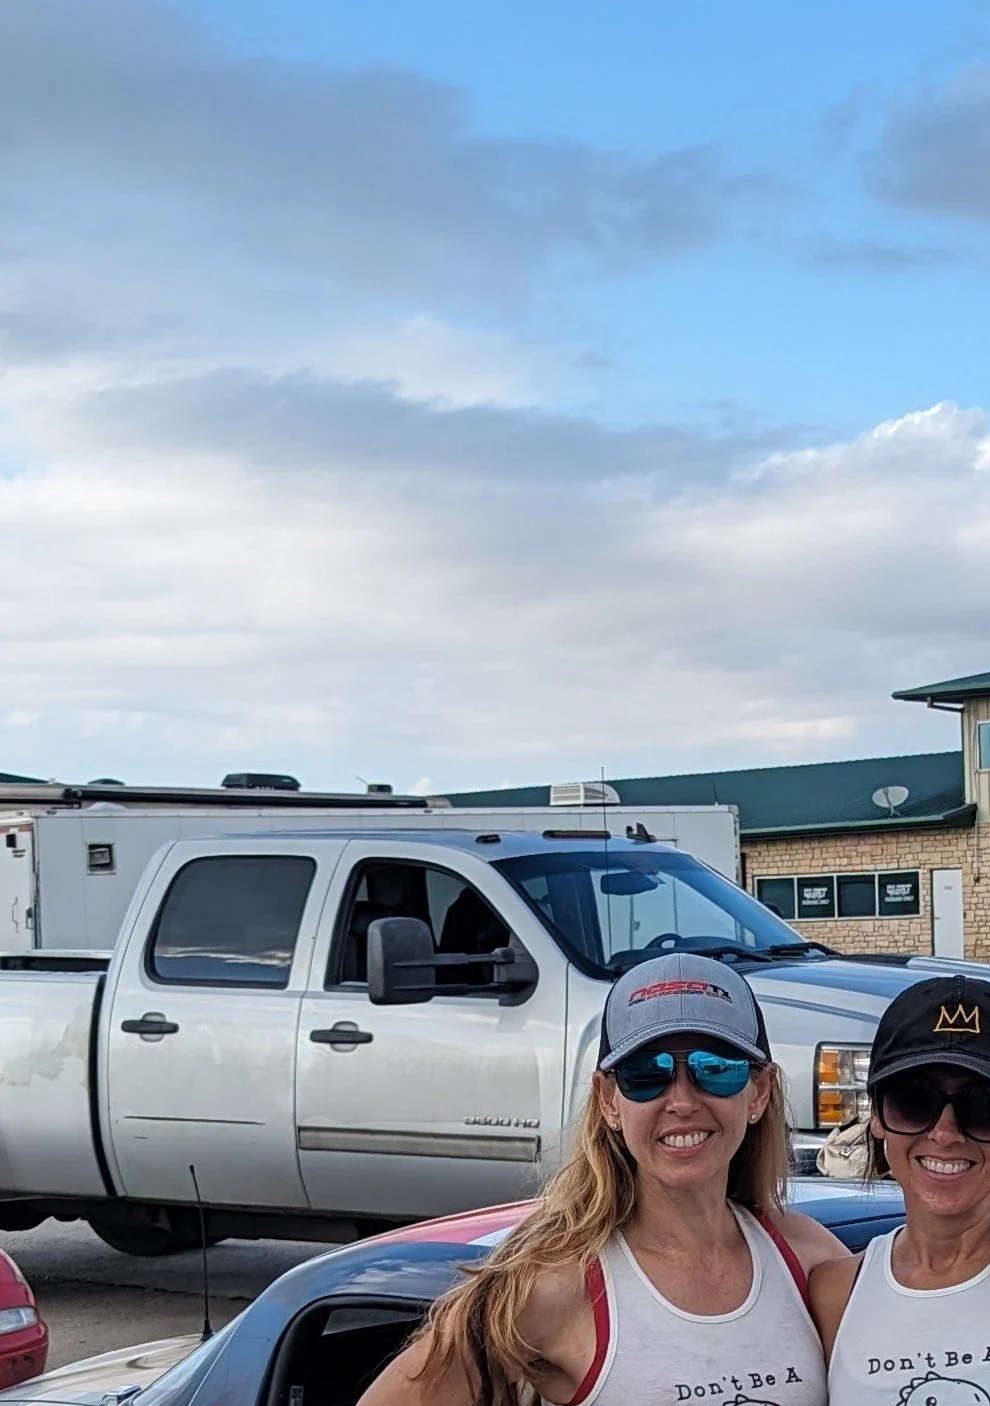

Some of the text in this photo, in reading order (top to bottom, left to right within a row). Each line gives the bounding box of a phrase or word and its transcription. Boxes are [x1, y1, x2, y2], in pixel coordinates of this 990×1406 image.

[867, 1352, 936, 1375] Don't
[945, 1351, 973, 1367] Be
[675, 1367, 802, 1400] Don't Be A
